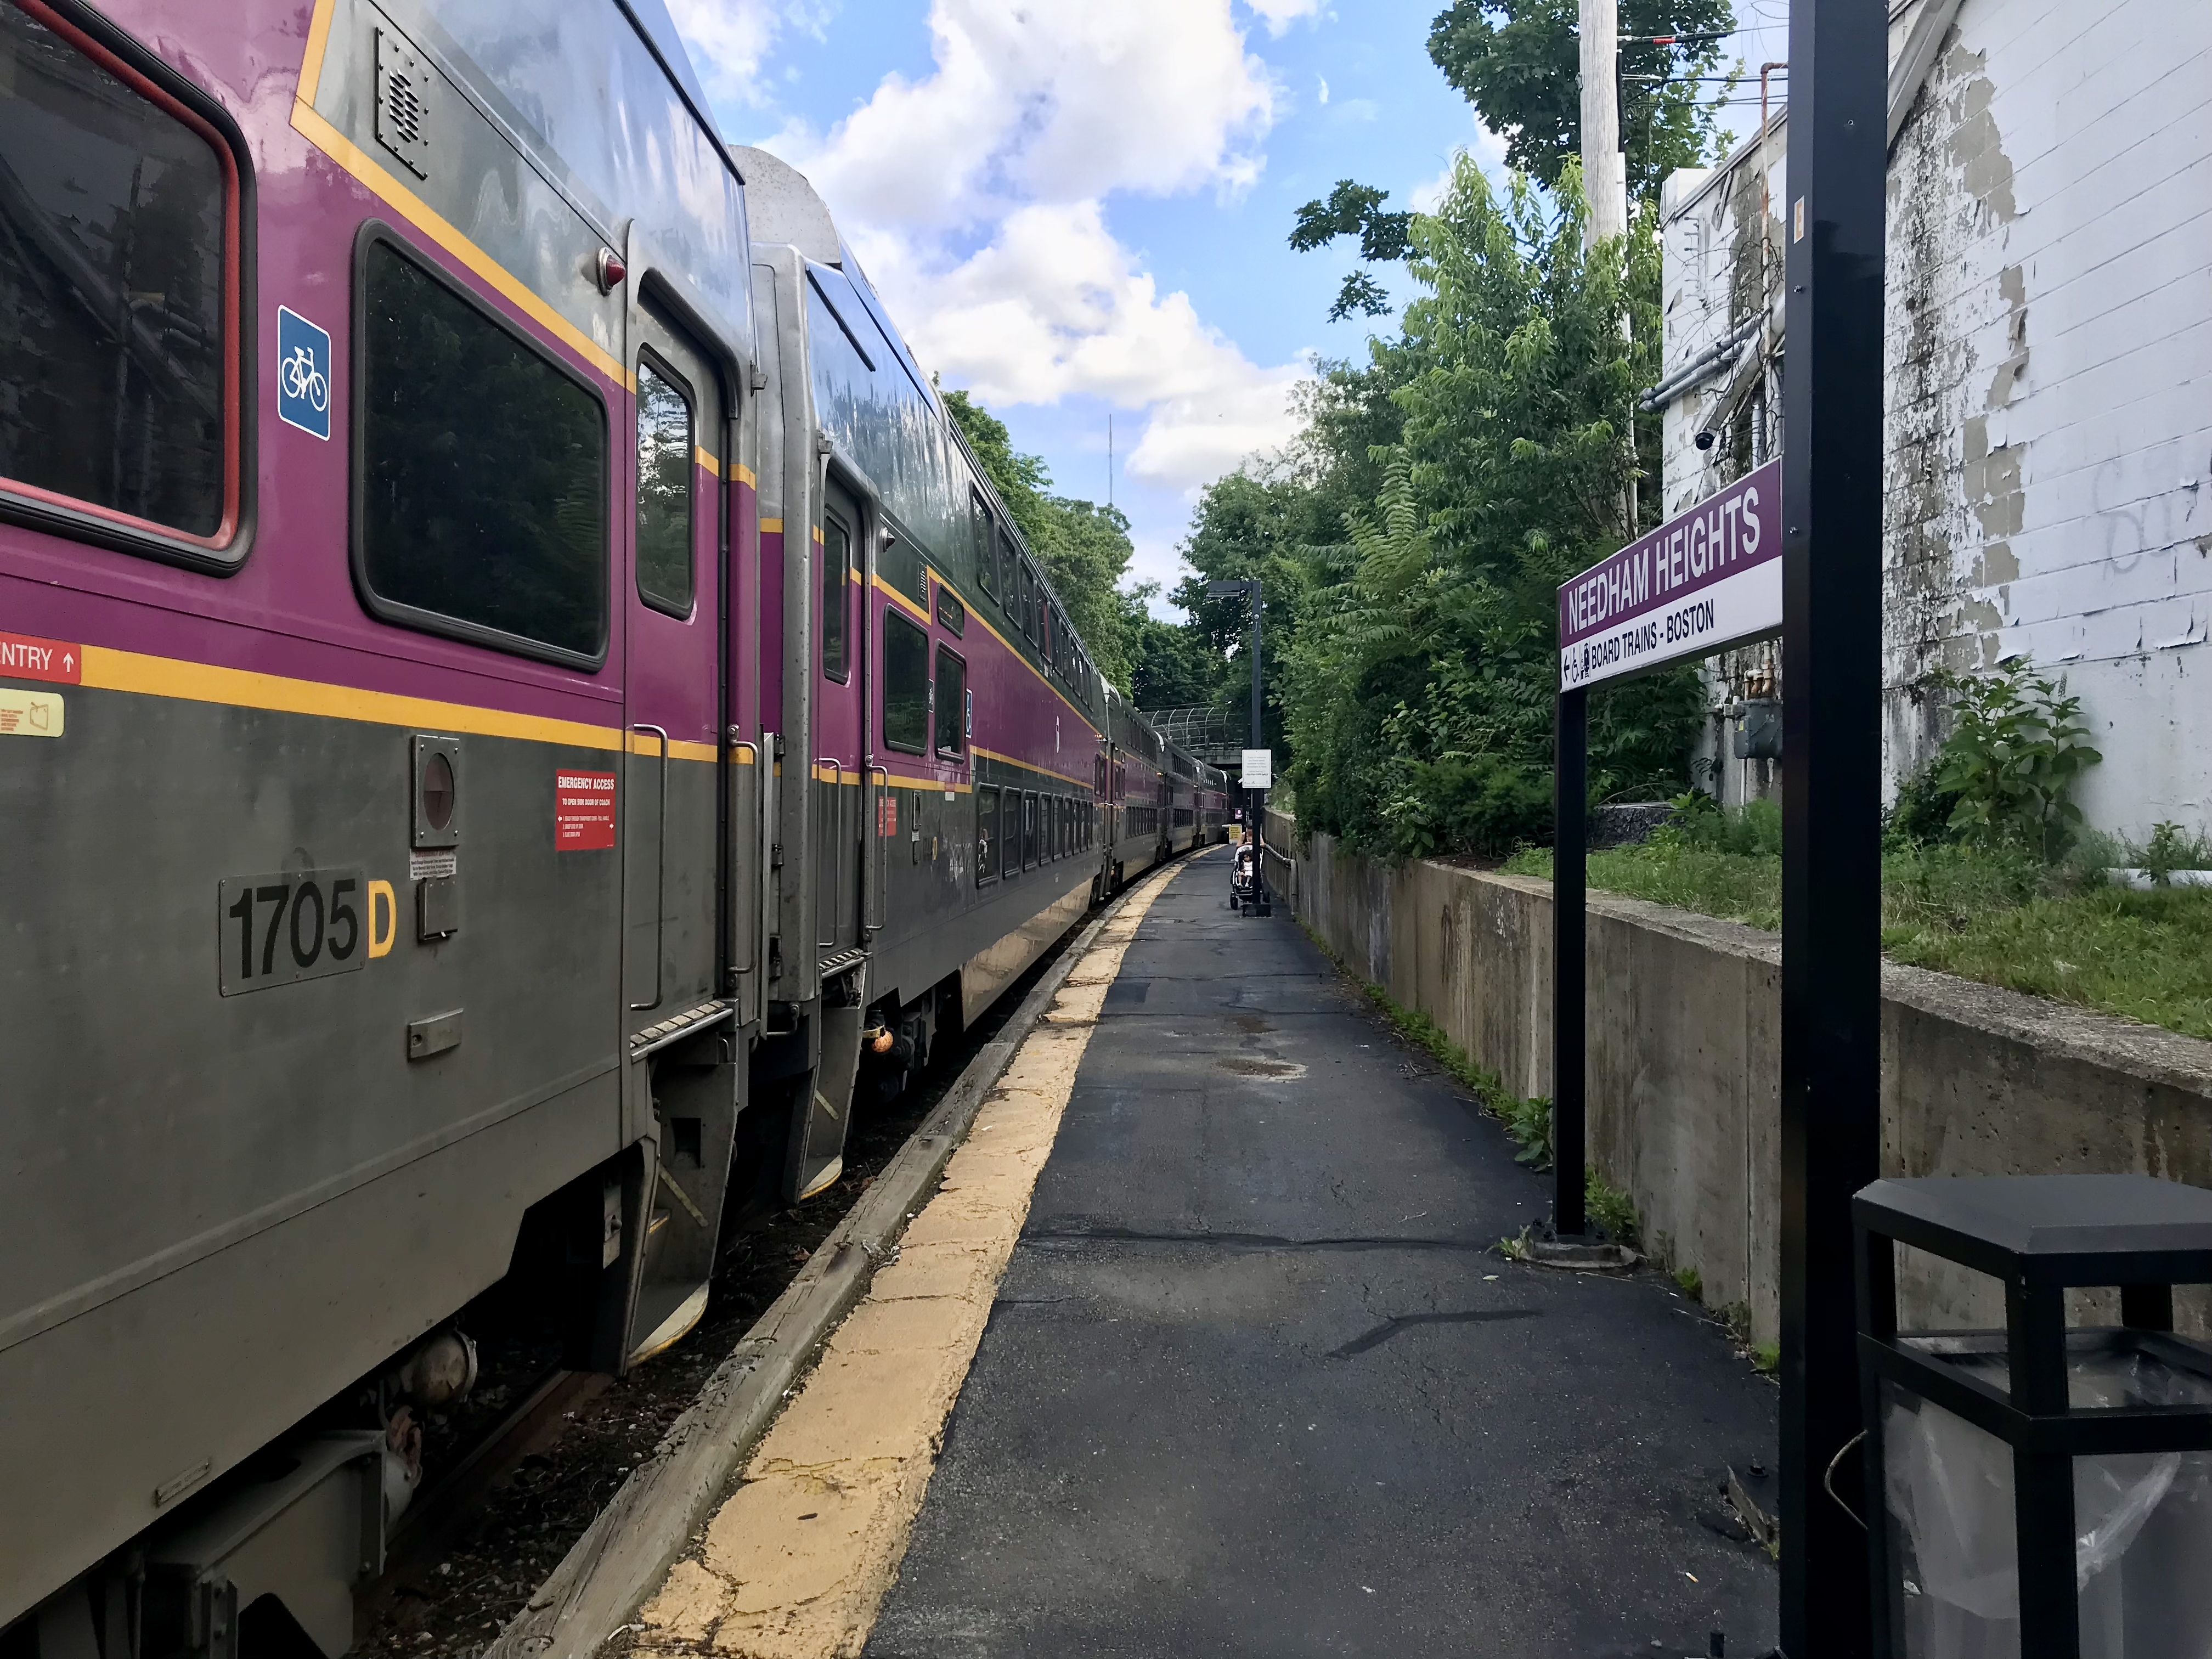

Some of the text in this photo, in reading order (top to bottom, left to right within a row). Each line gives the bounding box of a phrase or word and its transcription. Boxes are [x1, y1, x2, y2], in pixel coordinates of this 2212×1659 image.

[1568, 487, 1760, 635] NEEDHAM HEIGHTS
[0, 642, 53, 670] NTRY
[1592, 636, 1620, 670] BOARD
[1622, 622, 1657, 659] TRAINS
[1667, 598, 1714, 644] BOSTON
[558, 776, 614, 790] EMERGENCY ACCESS
[229, 878, 397, 979] 1705 D
